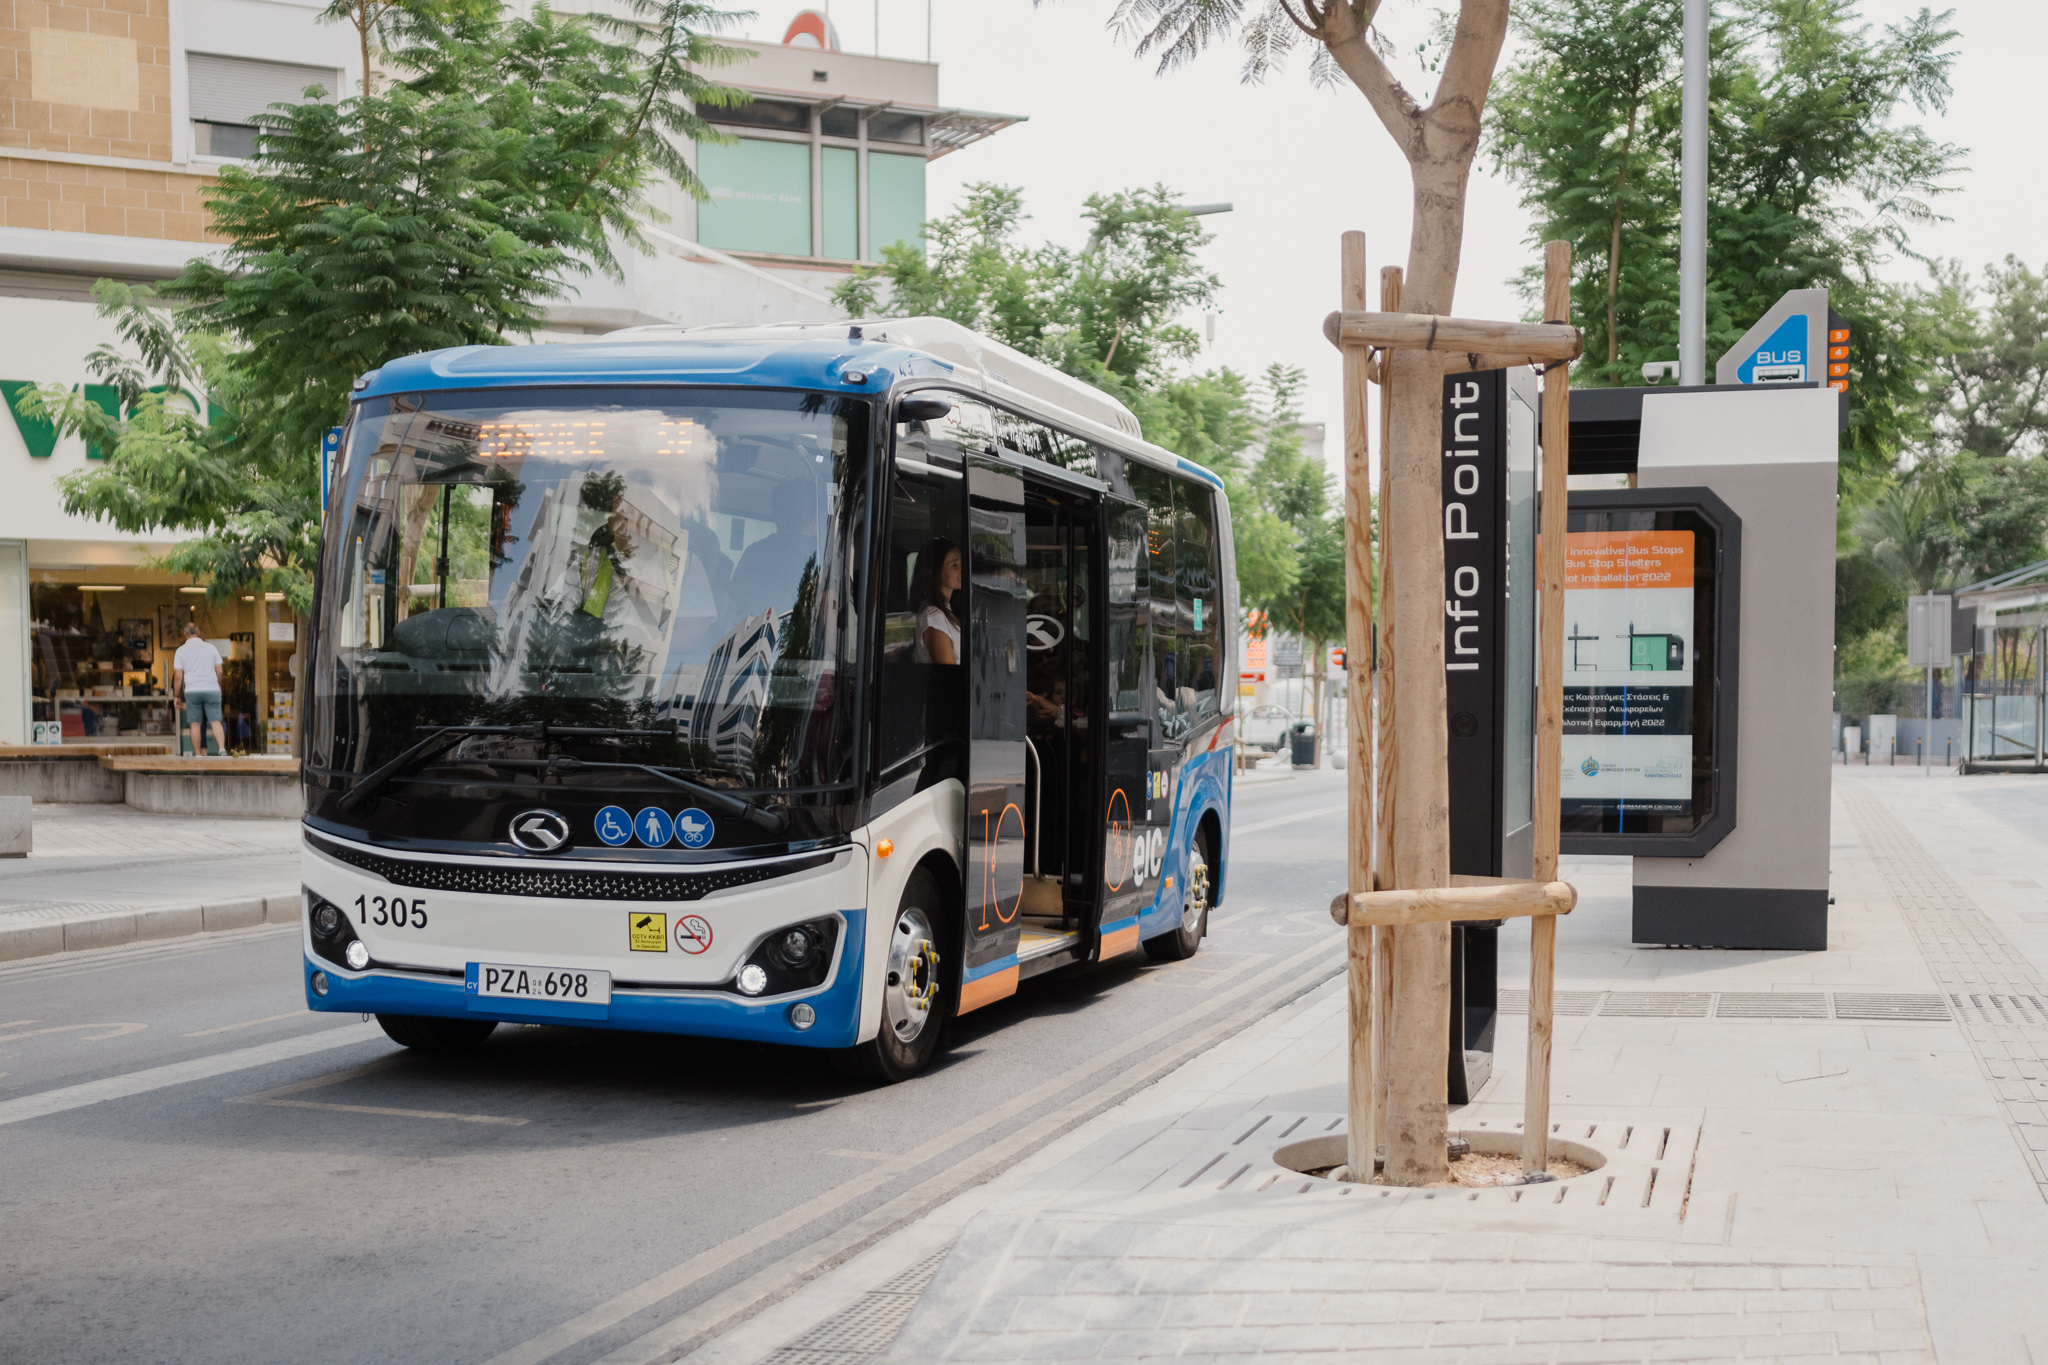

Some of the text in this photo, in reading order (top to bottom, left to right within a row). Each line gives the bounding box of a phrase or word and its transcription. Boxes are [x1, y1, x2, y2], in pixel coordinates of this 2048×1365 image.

[1835, 331, 1842, 339] 3
[1757, 350, 1802, 364] BUS
[1834, 348, 1842, 356] 4
[1834, 365, 1841, 373] 5
[1445, 381, 1480, 670] Info Point
[1570, 546, 1625, 556] Innovative
[1628, 546, 1649, 555] Bus
[1651, 545, 1684, 556] Stops
[1565, 558, 1662, 569] Bus Stop Shelters
[1581, 573, 1639, 582] Installation
[1641, 572, 1672, 581] 2022
[355, 894, 428, 929] 1305
[467, 981, 478, 989] CY
[485, 968, 588, 998] PZA 698
